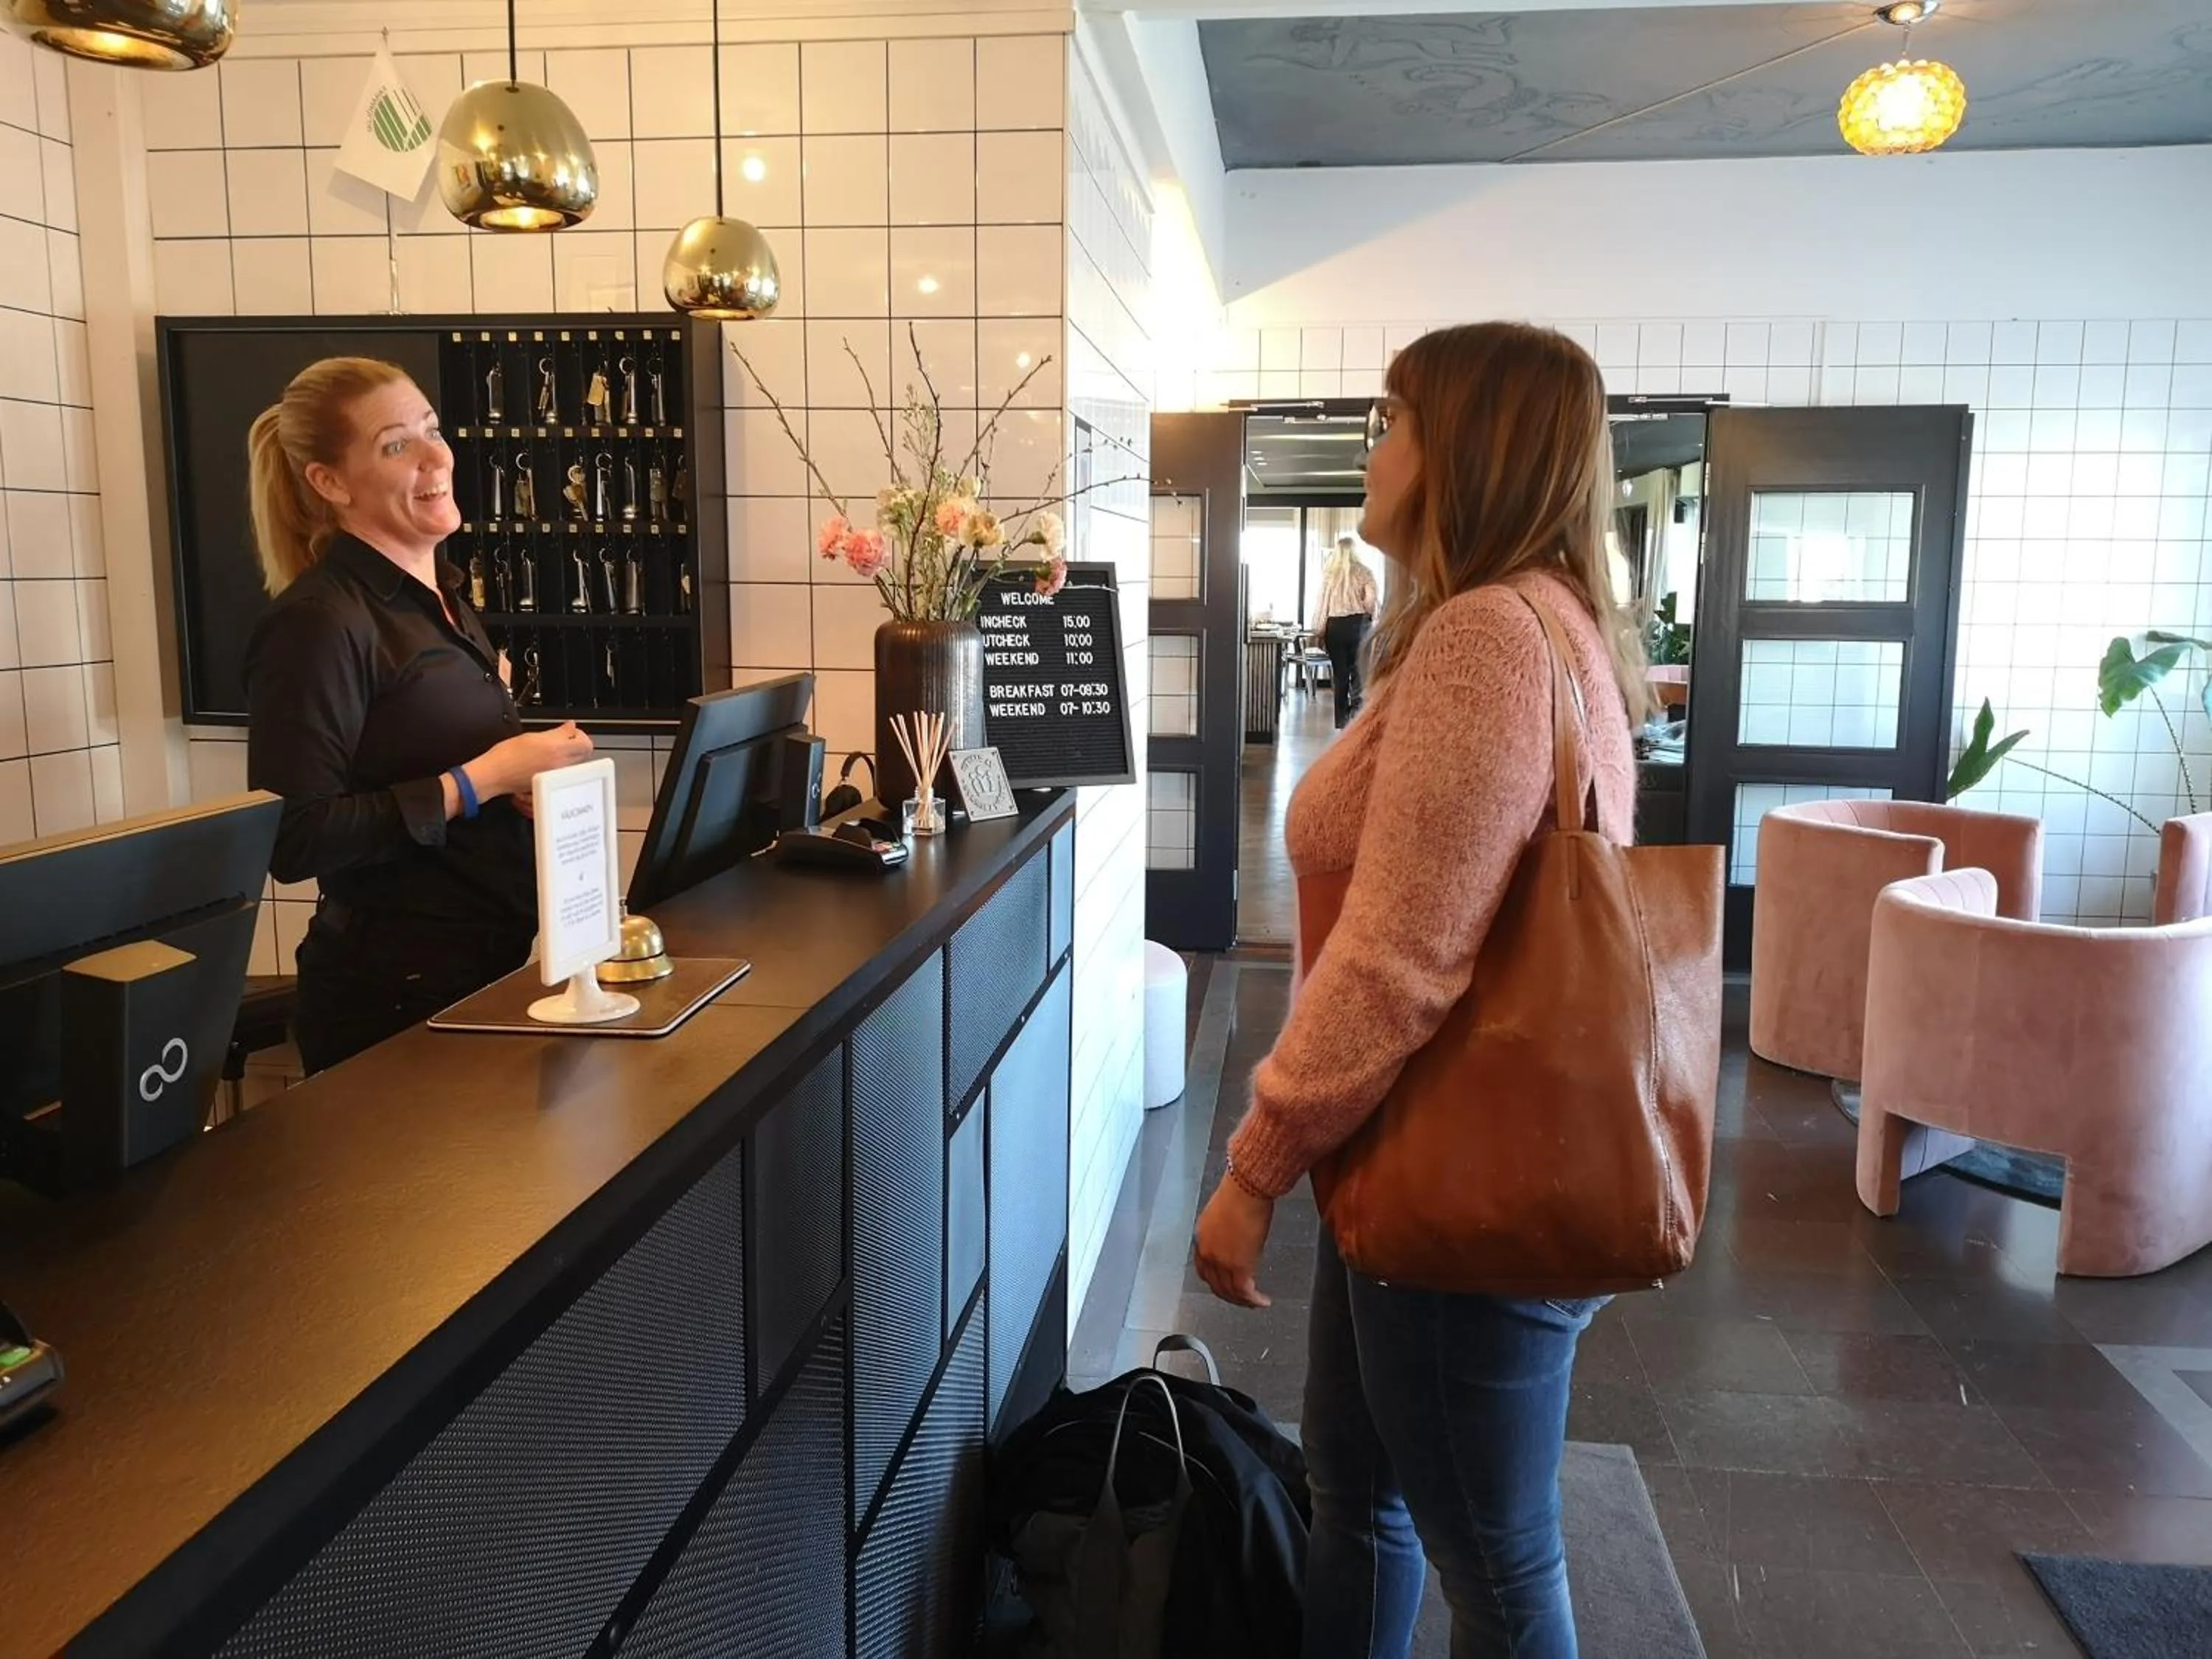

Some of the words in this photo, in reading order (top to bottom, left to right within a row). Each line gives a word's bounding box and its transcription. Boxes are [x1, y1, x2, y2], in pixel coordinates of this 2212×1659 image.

[1001, 592, 1055, 605] WELCOME
[980, 615, 1027, 628] INCHECK
[1062, 615, 1091, 628] 15:00
[983, 633, 1030, 647] UTCHECK
[1064, 633, 1092, 647] 10:00
[984, 653, 1039, 665] WEEKEND
[1065, 652, 1093, 665] 11:00
[989, 684, 1055, 698] BREAKFAST
[989, 703, 1046, 717] WEEKEND
